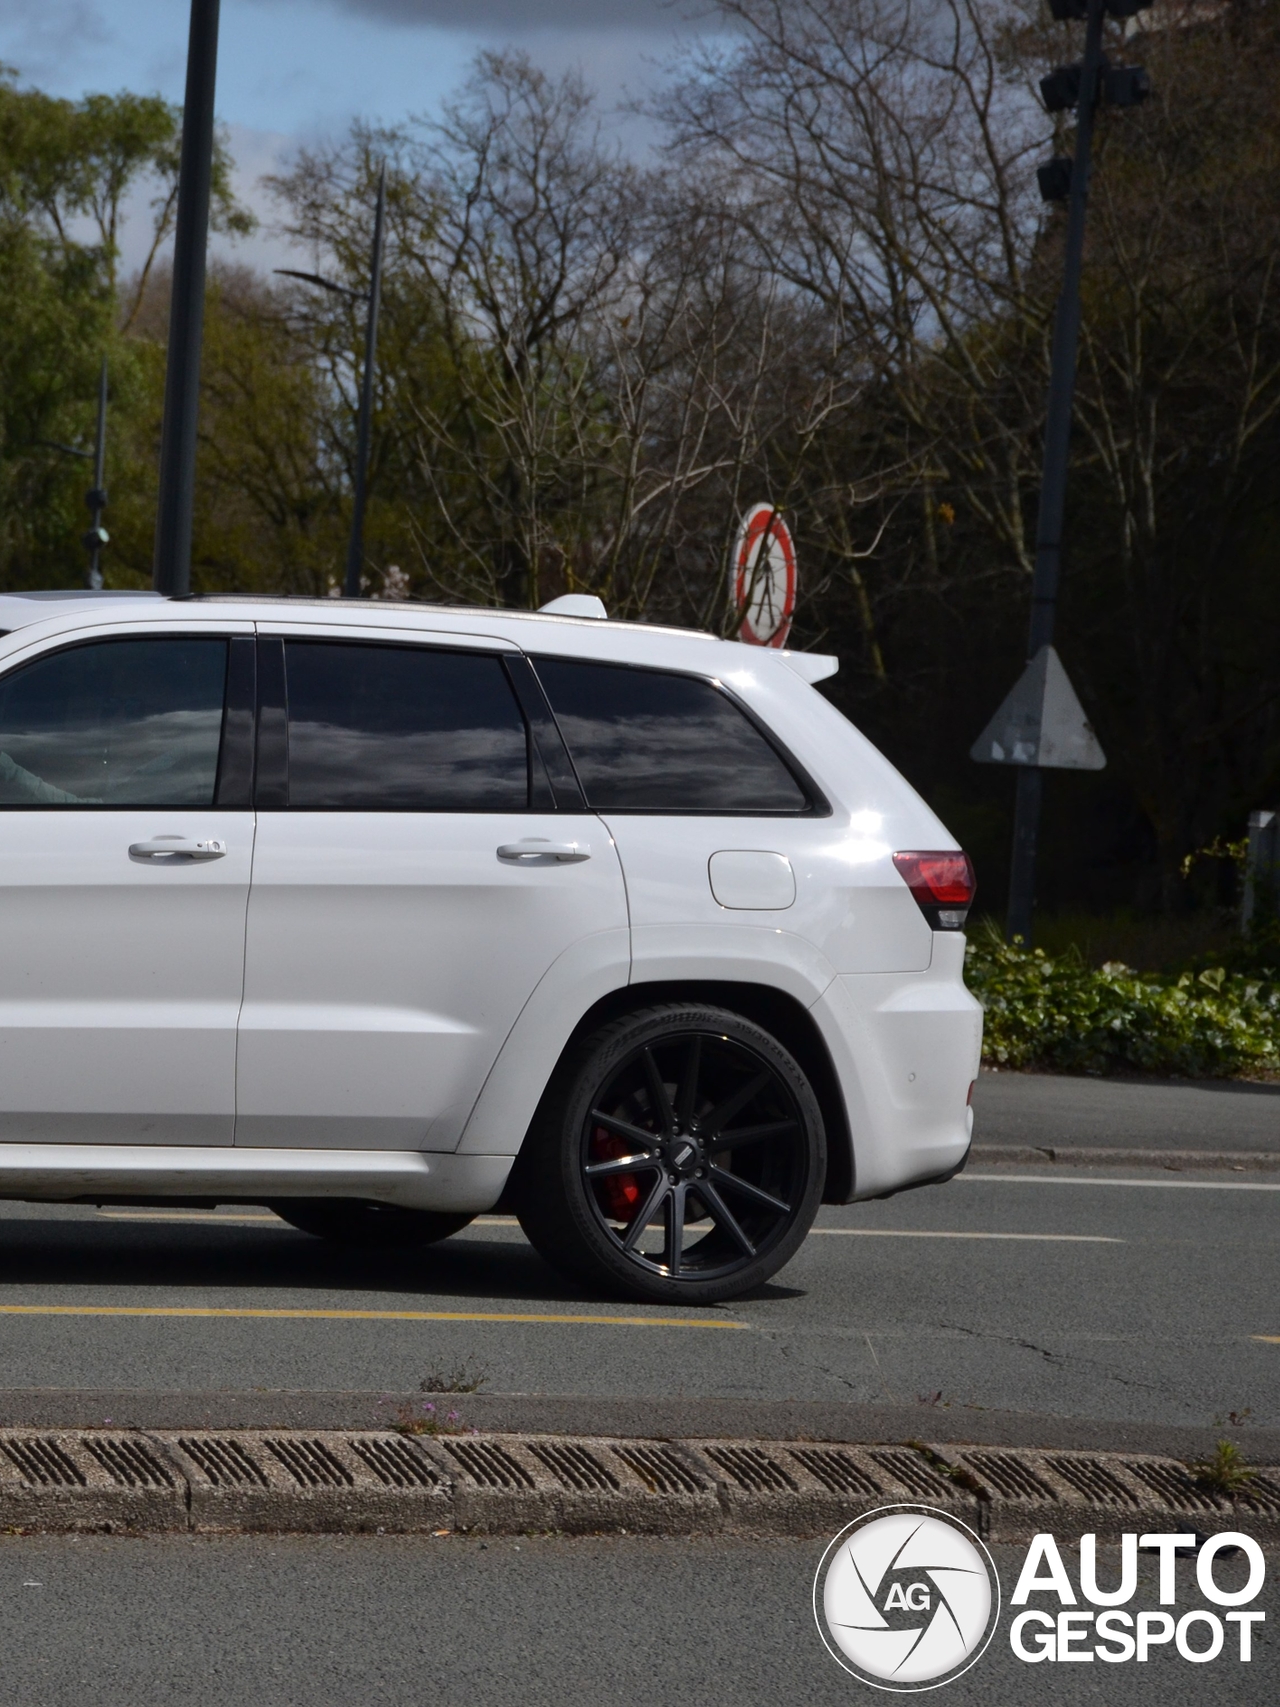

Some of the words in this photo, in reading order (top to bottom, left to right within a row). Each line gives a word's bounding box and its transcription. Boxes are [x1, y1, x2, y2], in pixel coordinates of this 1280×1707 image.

[732, 1020, 771, 1046] 315/30
[783, 1059, 796, 1073] 22
[794, 1074, 806, 1090] XL
